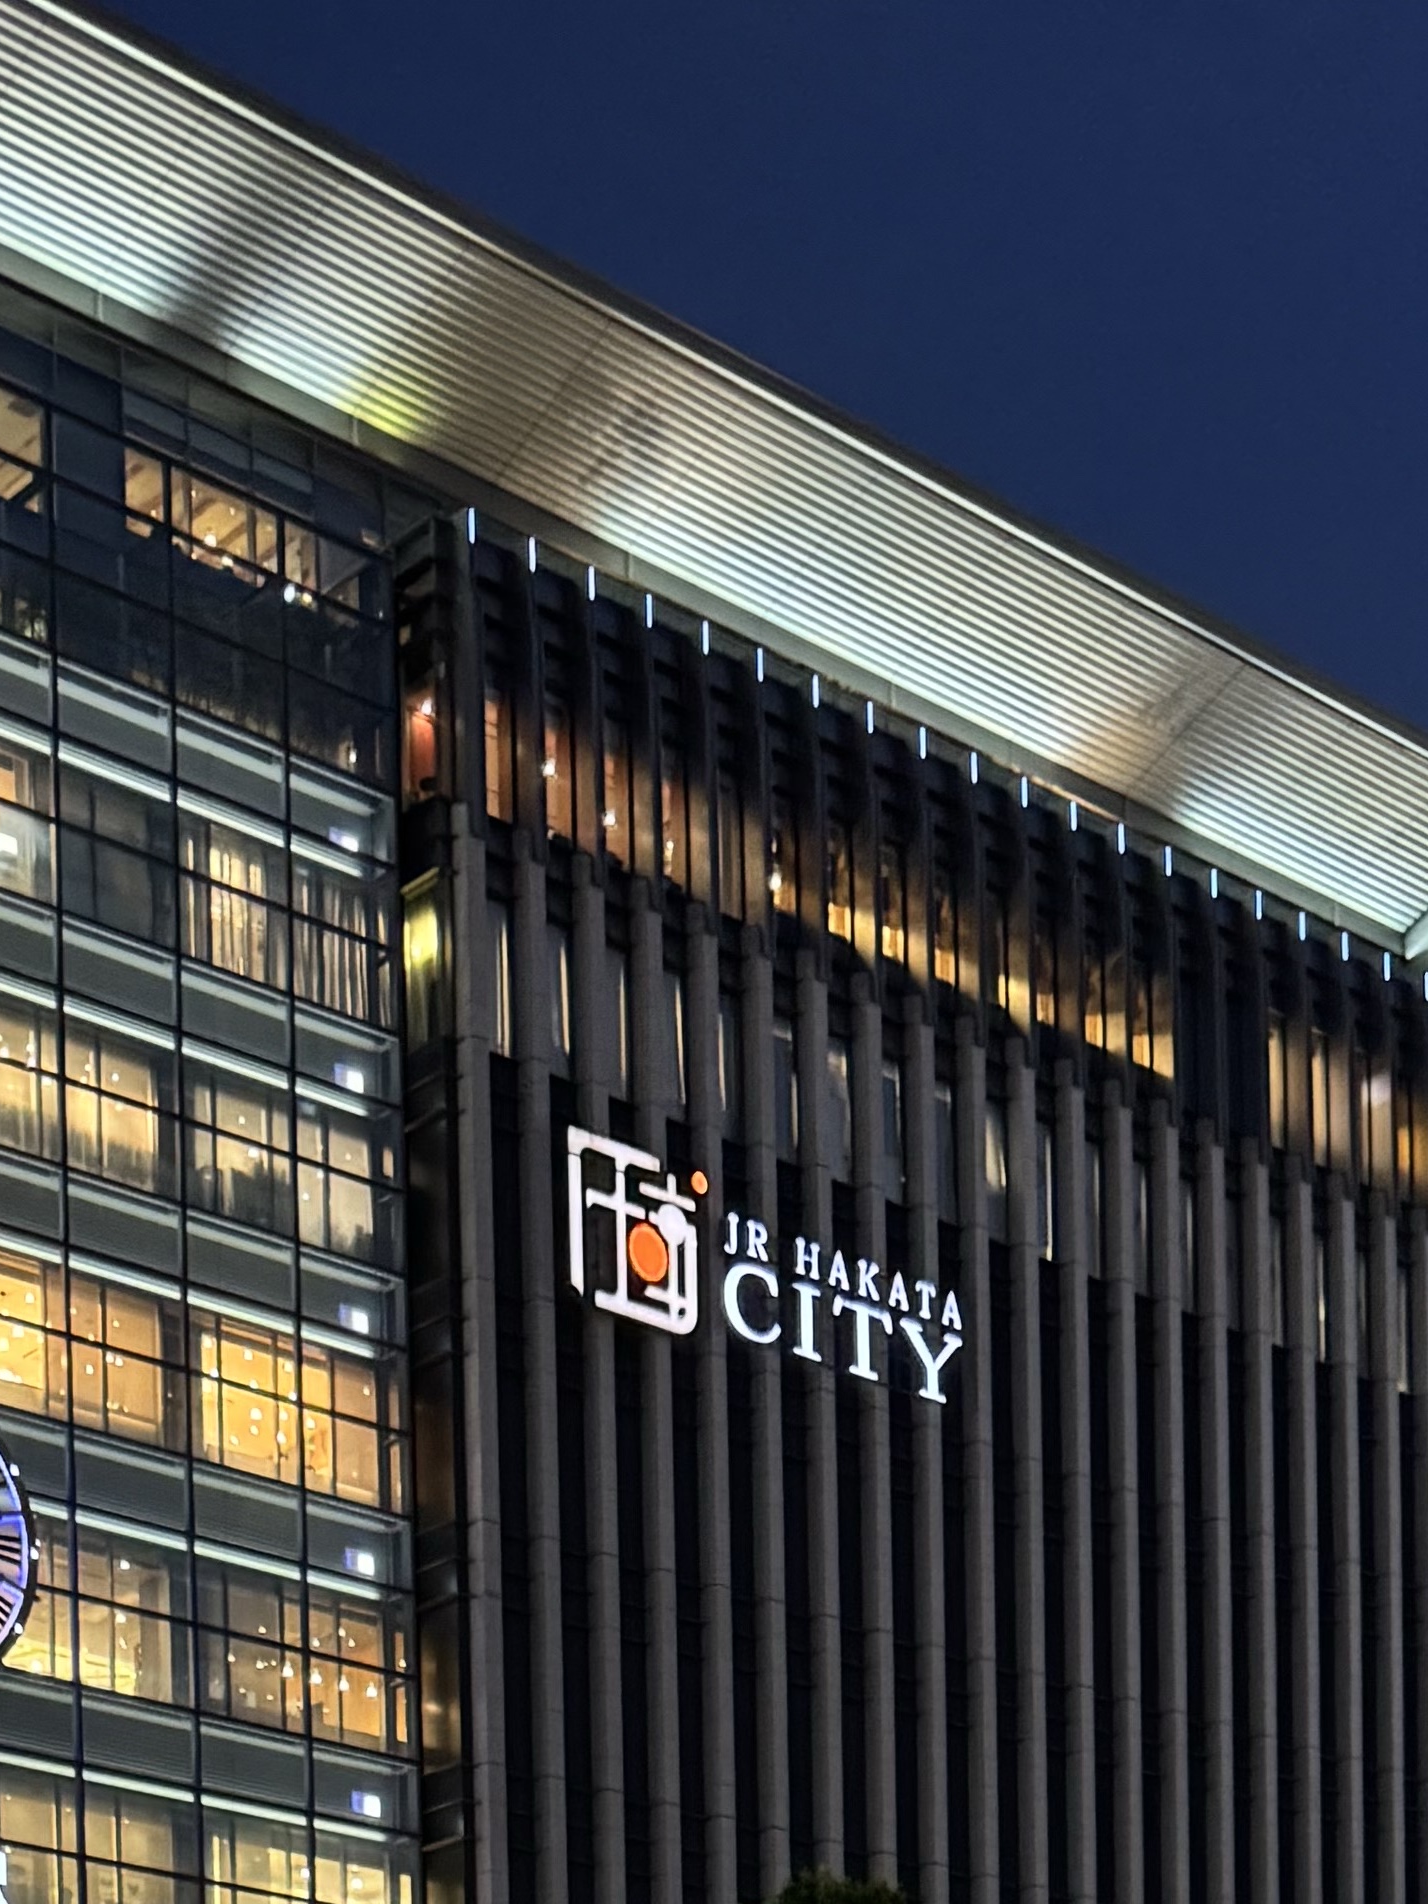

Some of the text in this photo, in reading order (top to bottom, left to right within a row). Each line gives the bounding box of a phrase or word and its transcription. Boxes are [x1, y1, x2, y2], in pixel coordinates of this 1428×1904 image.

[723, 1211, 963, 1332] JR HAKATA
[723, 1263, 964, 1405] CITY
